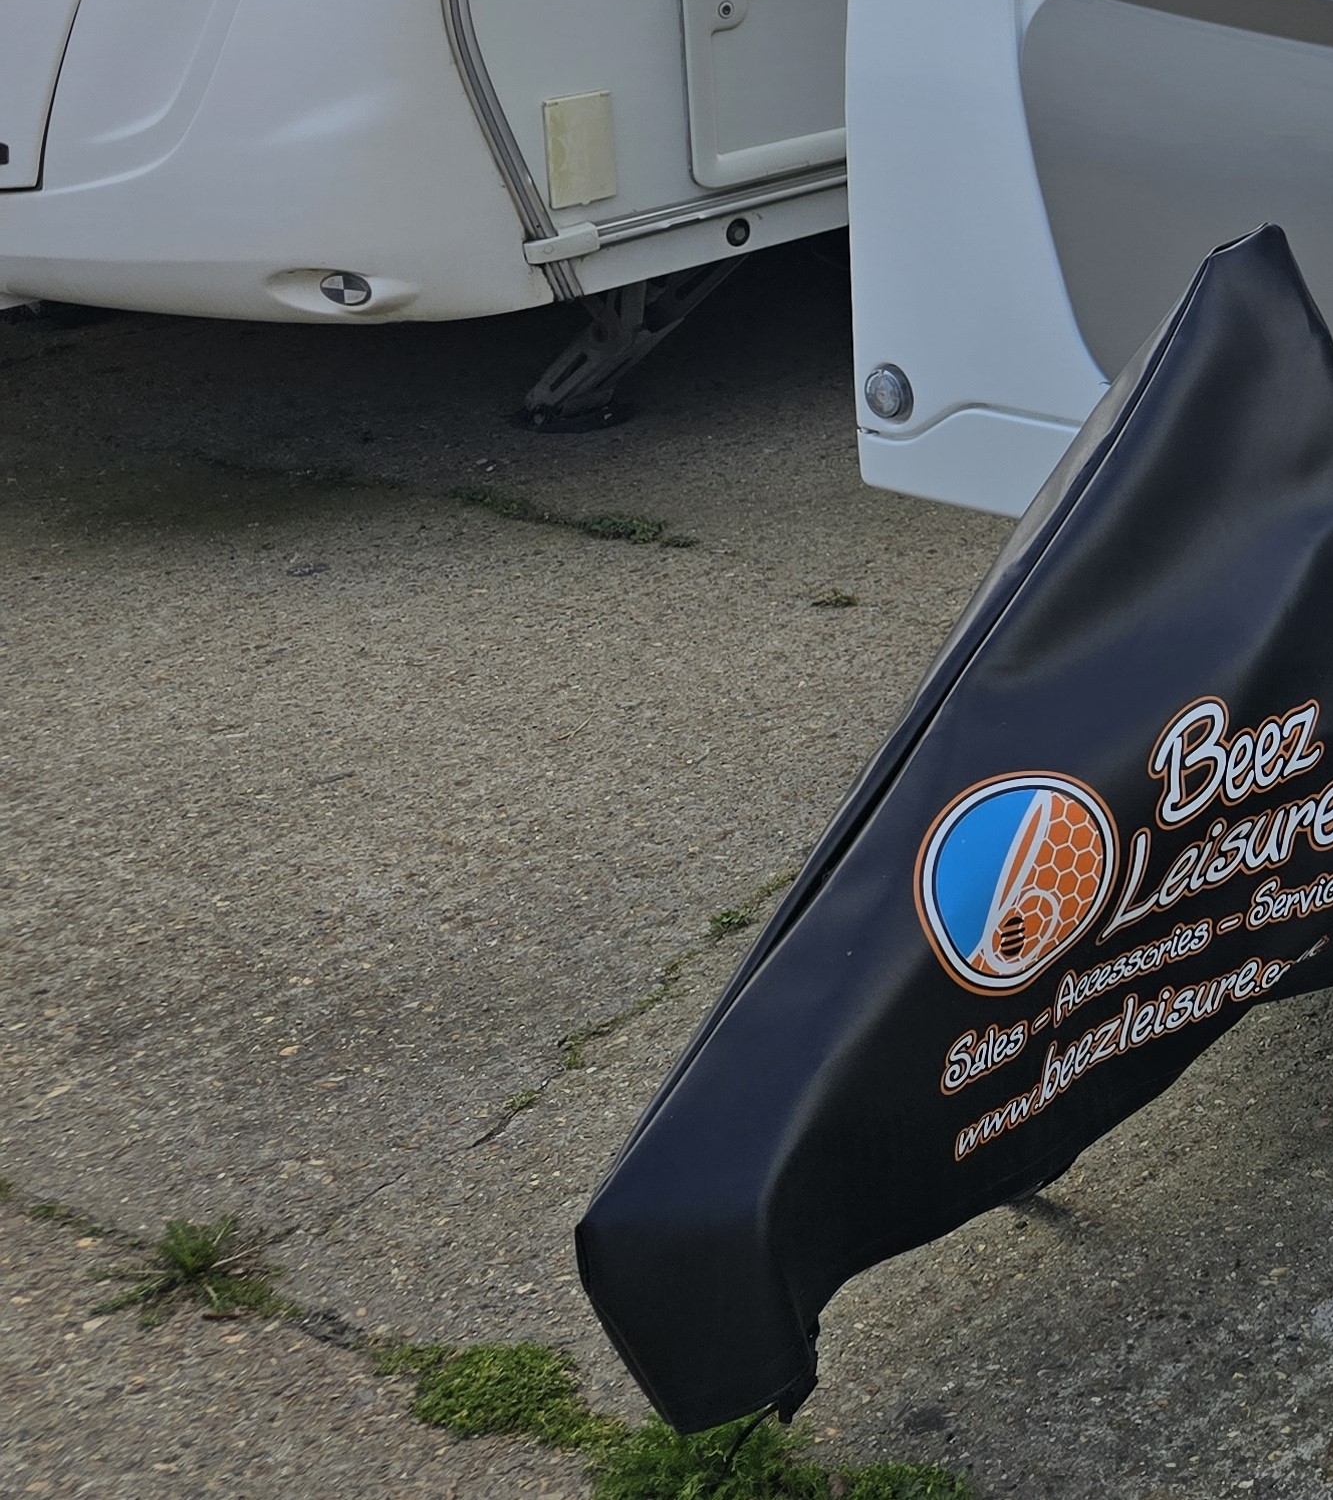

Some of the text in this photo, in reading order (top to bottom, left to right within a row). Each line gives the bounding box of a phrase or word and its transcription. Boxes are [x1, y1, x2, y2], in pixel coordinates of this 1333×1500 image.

[1150, 698, 1323, 826] Beez
[943, 1022, 1026, 1091] Sales
[1054, 920, 1210, 1023] Accessories
